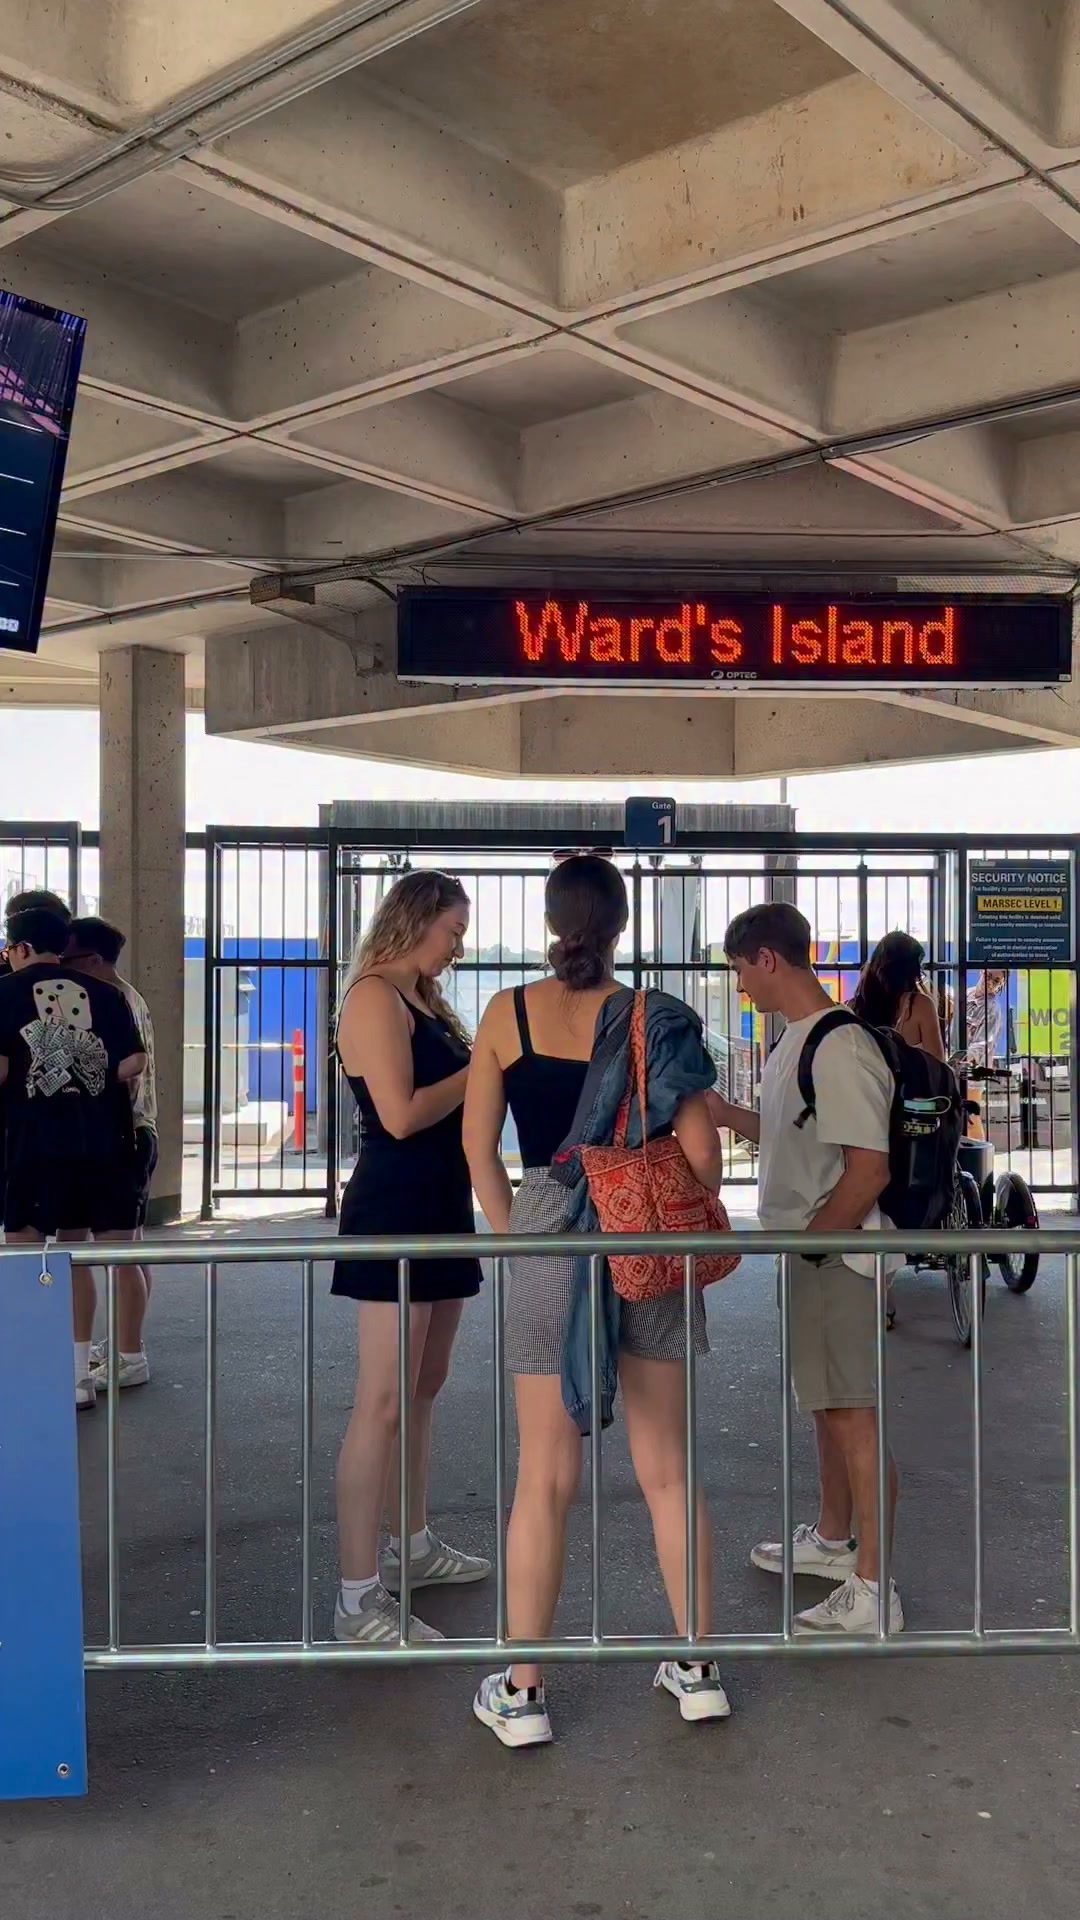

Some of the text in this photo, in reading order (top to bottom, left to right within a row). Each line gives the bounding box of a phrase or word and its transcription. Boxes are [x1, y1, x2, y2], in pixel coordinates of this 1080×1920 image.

[515, 600, 955, 665] Ward's Island
[726, 671, 757, 679] OPTEC
[651, 801, 672, 810] Gate
[657, 815, 672, 844] 1
[971, 873, 1067, 883] SECURITY NOTICE
[983, 899, 1023, 908] MARSEC
[1024, 899, 1051, 908] LEVEL
